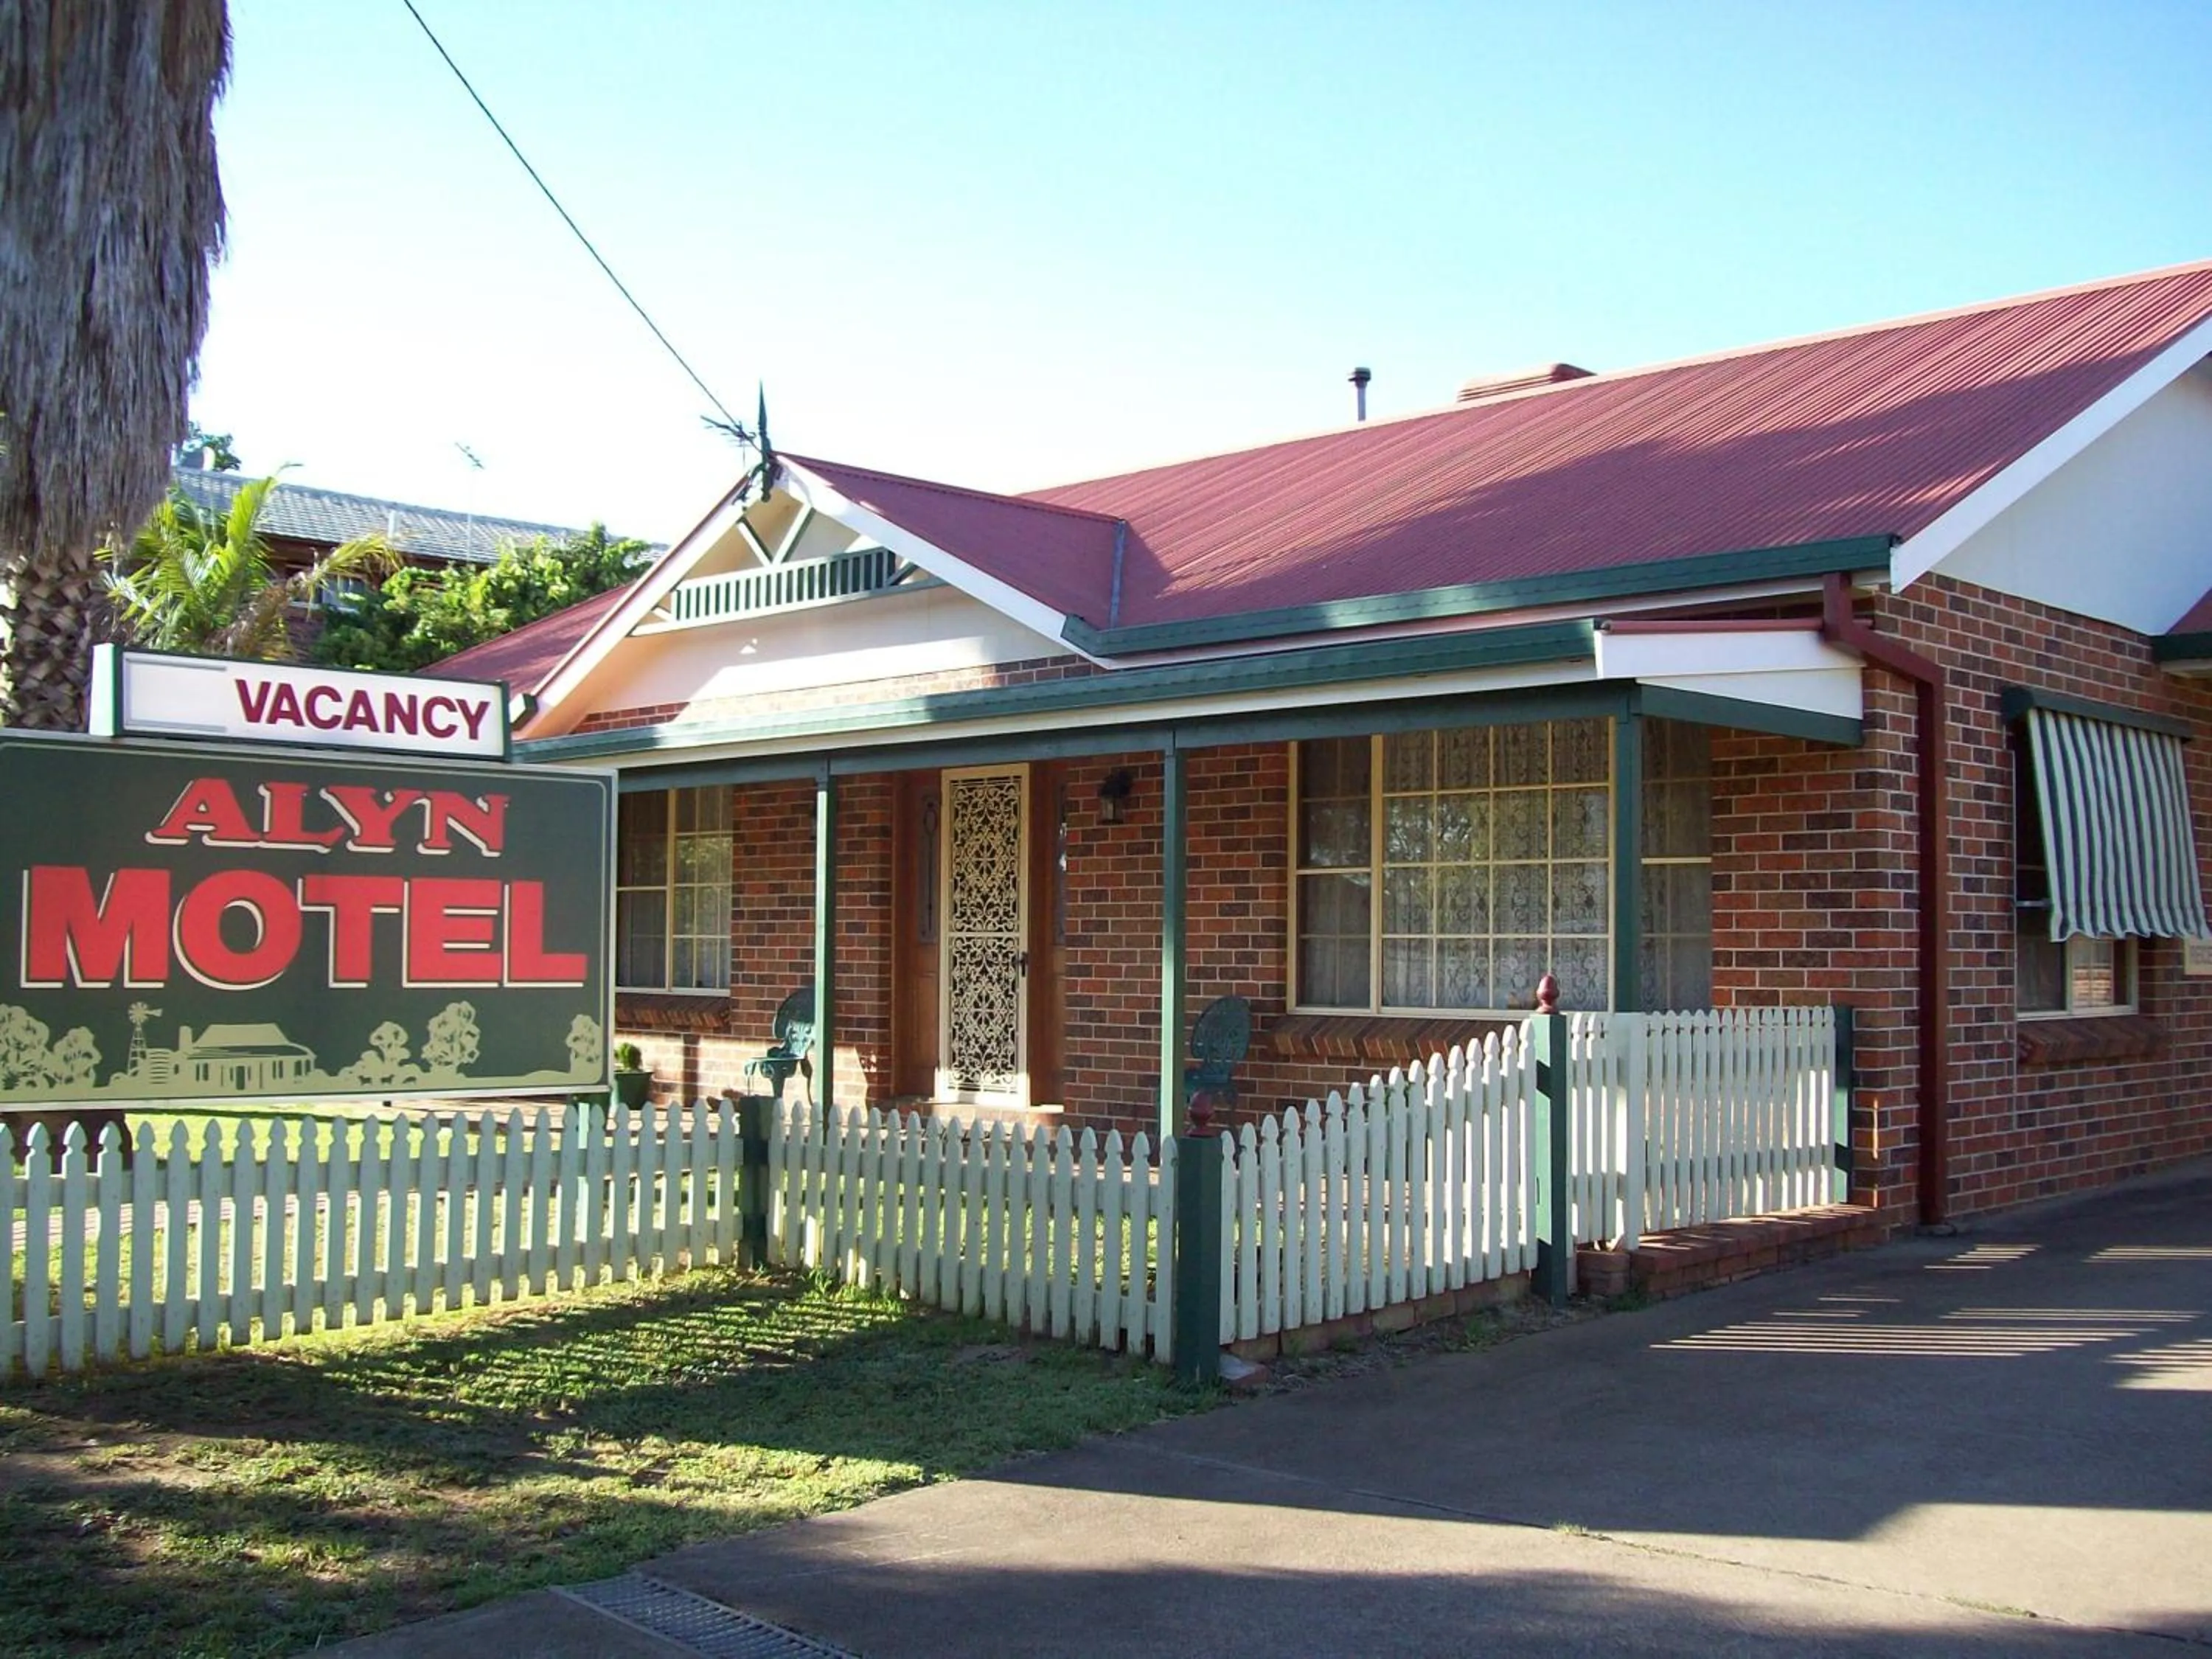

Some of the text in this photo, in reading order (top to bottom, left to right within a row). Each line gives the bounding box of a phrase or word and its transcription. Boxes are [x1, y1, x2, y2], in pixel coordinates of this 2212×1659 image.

[235, 678, 490, 740] VACANCY
[145, 777, 510, 857] ALYN
[21, 864, 588, 990] MOTEL
